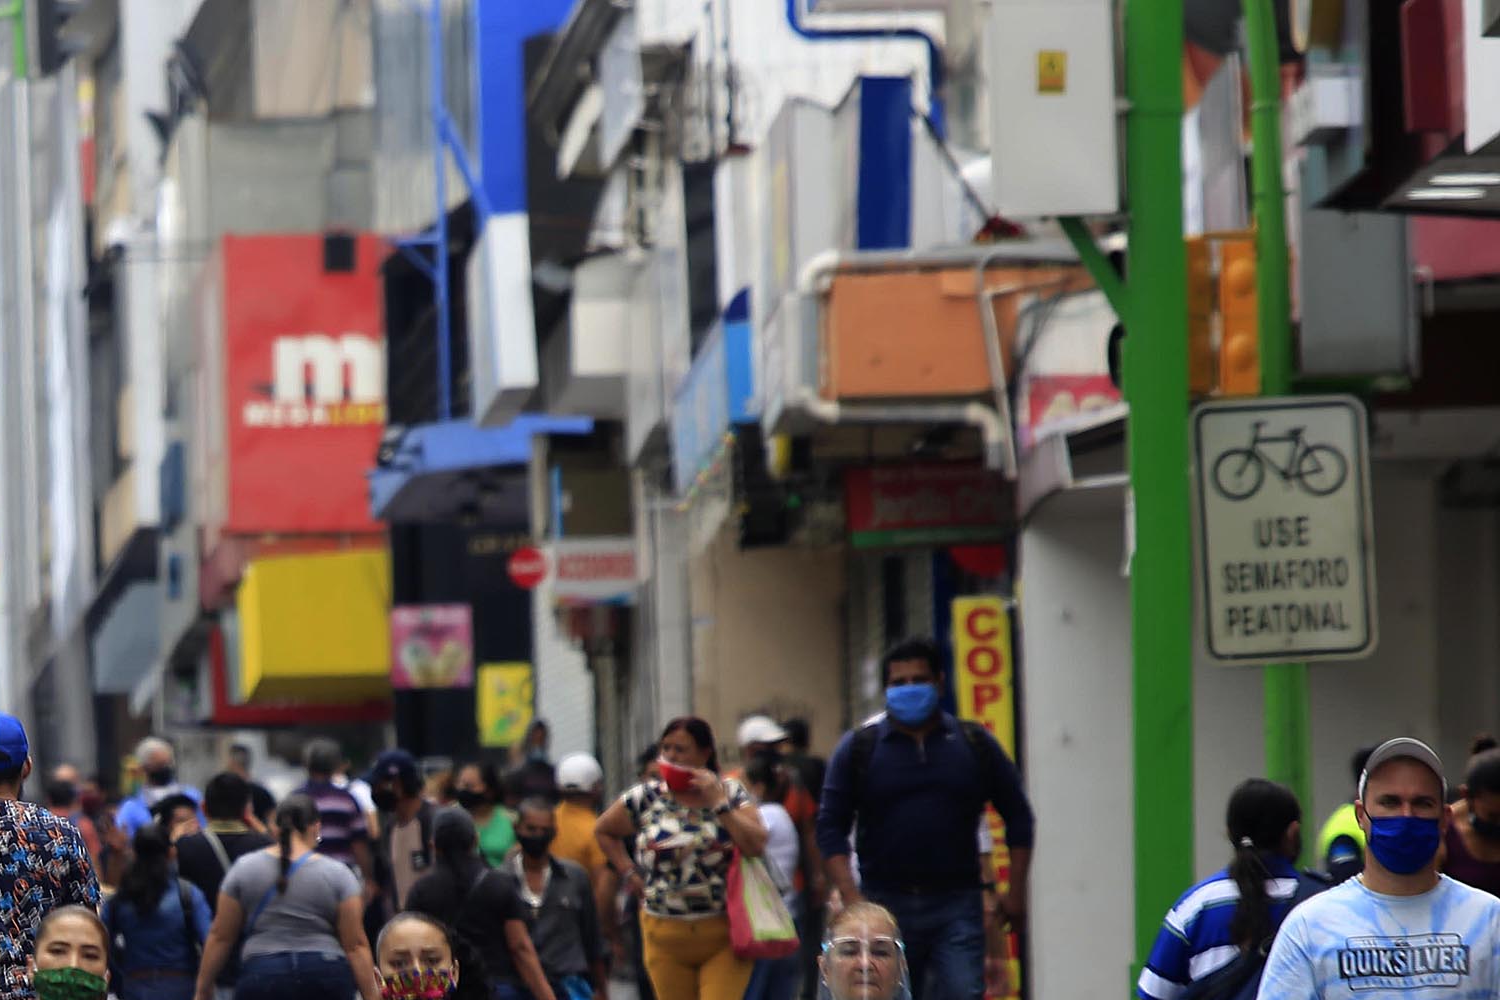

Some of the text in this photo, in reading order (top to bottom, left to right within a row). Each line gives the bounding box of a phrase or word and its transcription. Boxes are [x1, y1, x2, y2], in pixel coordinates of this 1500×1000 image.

[1254, 516, 1311, 548] USE
[1224, 556, 1349, 594] SEMAFORO
[1226, 601, 1350, 637] PEATONAL
[1342, 946, 1468, 977] QUIKSILVER
